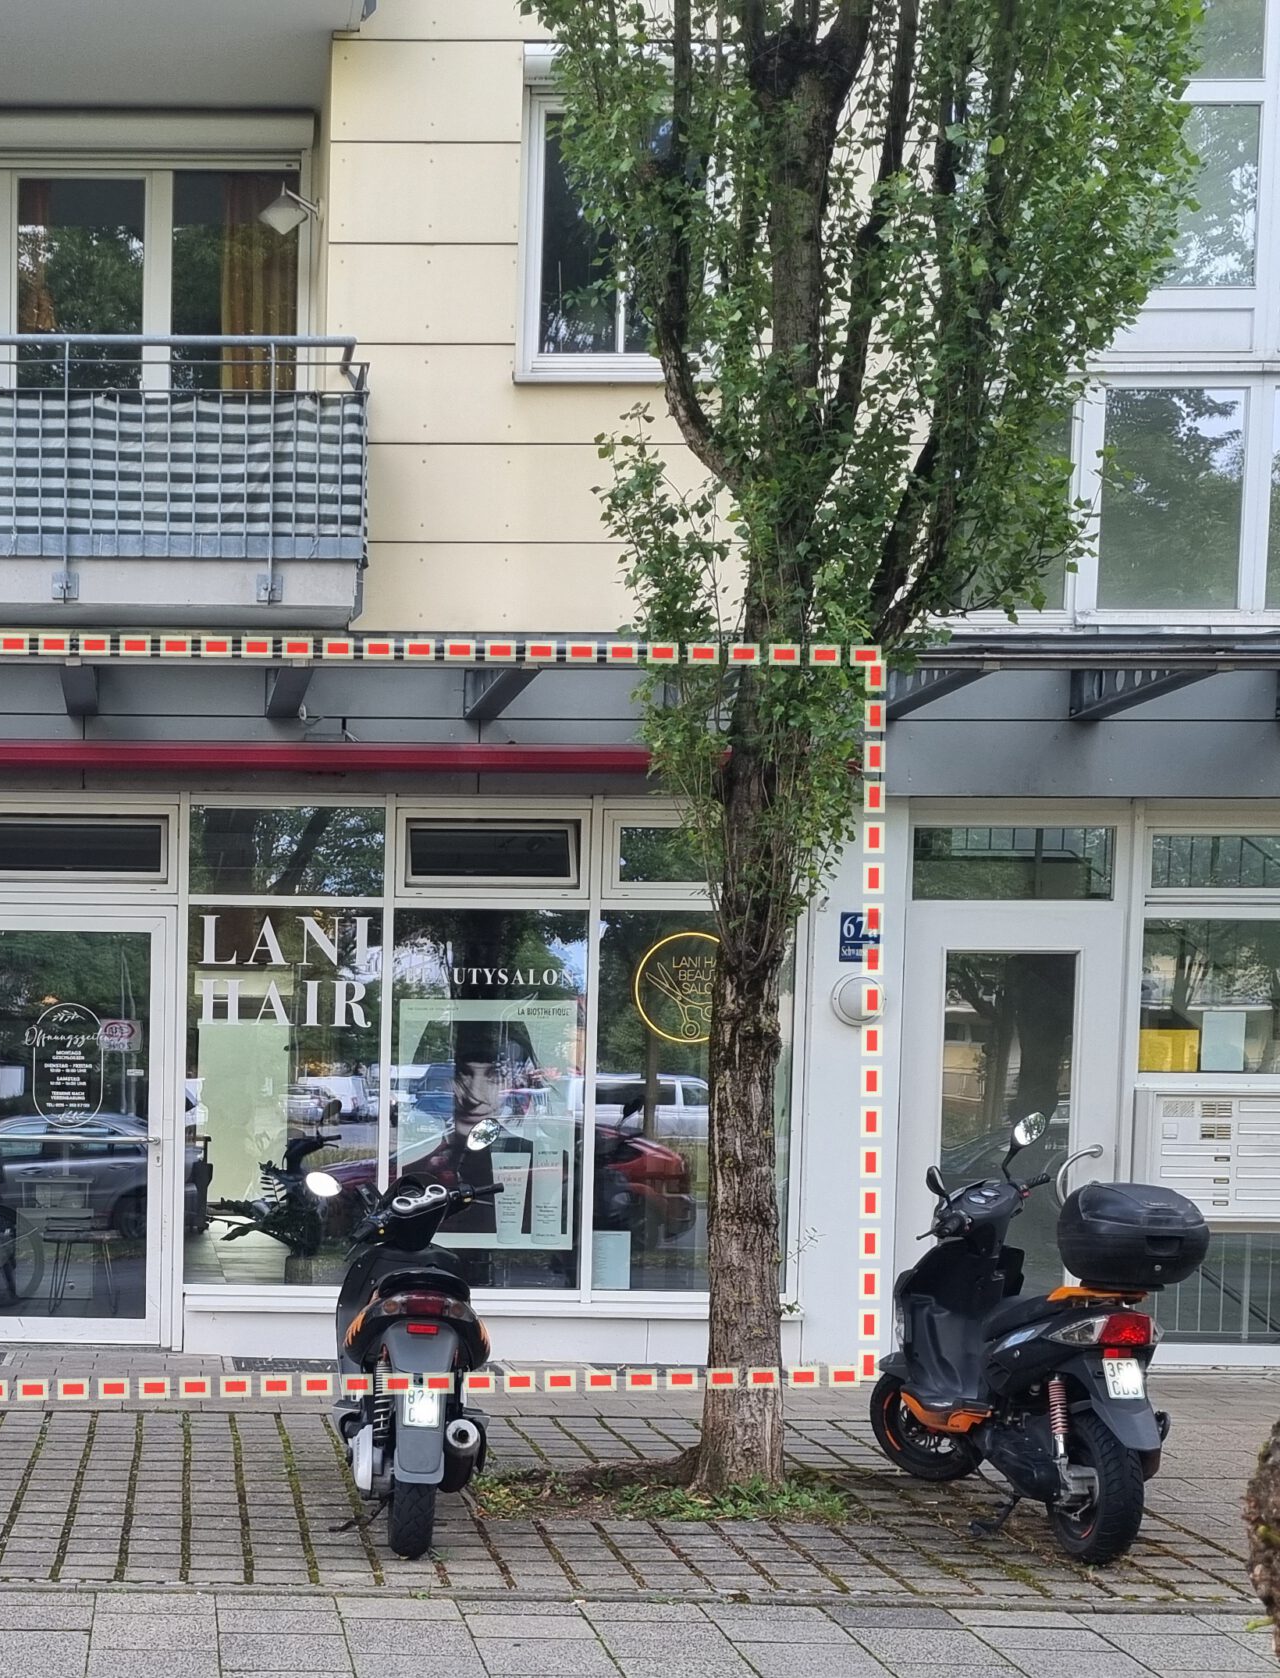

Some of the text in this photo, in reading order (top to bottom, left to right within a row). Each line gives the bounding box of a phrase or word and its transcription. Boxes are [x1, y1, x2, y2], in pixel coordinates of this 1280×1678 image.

[197, 914, 373, 966] LANI
[672, 955, 701, 968] LANI
[405, 967, 574, 986] BEAUTYSALON
[678, 969, 717, 982] BEAUT
[198, 978, 373, 1028] HAIR
[517, 1007, 525, 1016] LA
[526, 1007, 571, 1017] BIOSTHETIQUE
[24, 1024, 110, 1048] Öffnungszeiten
